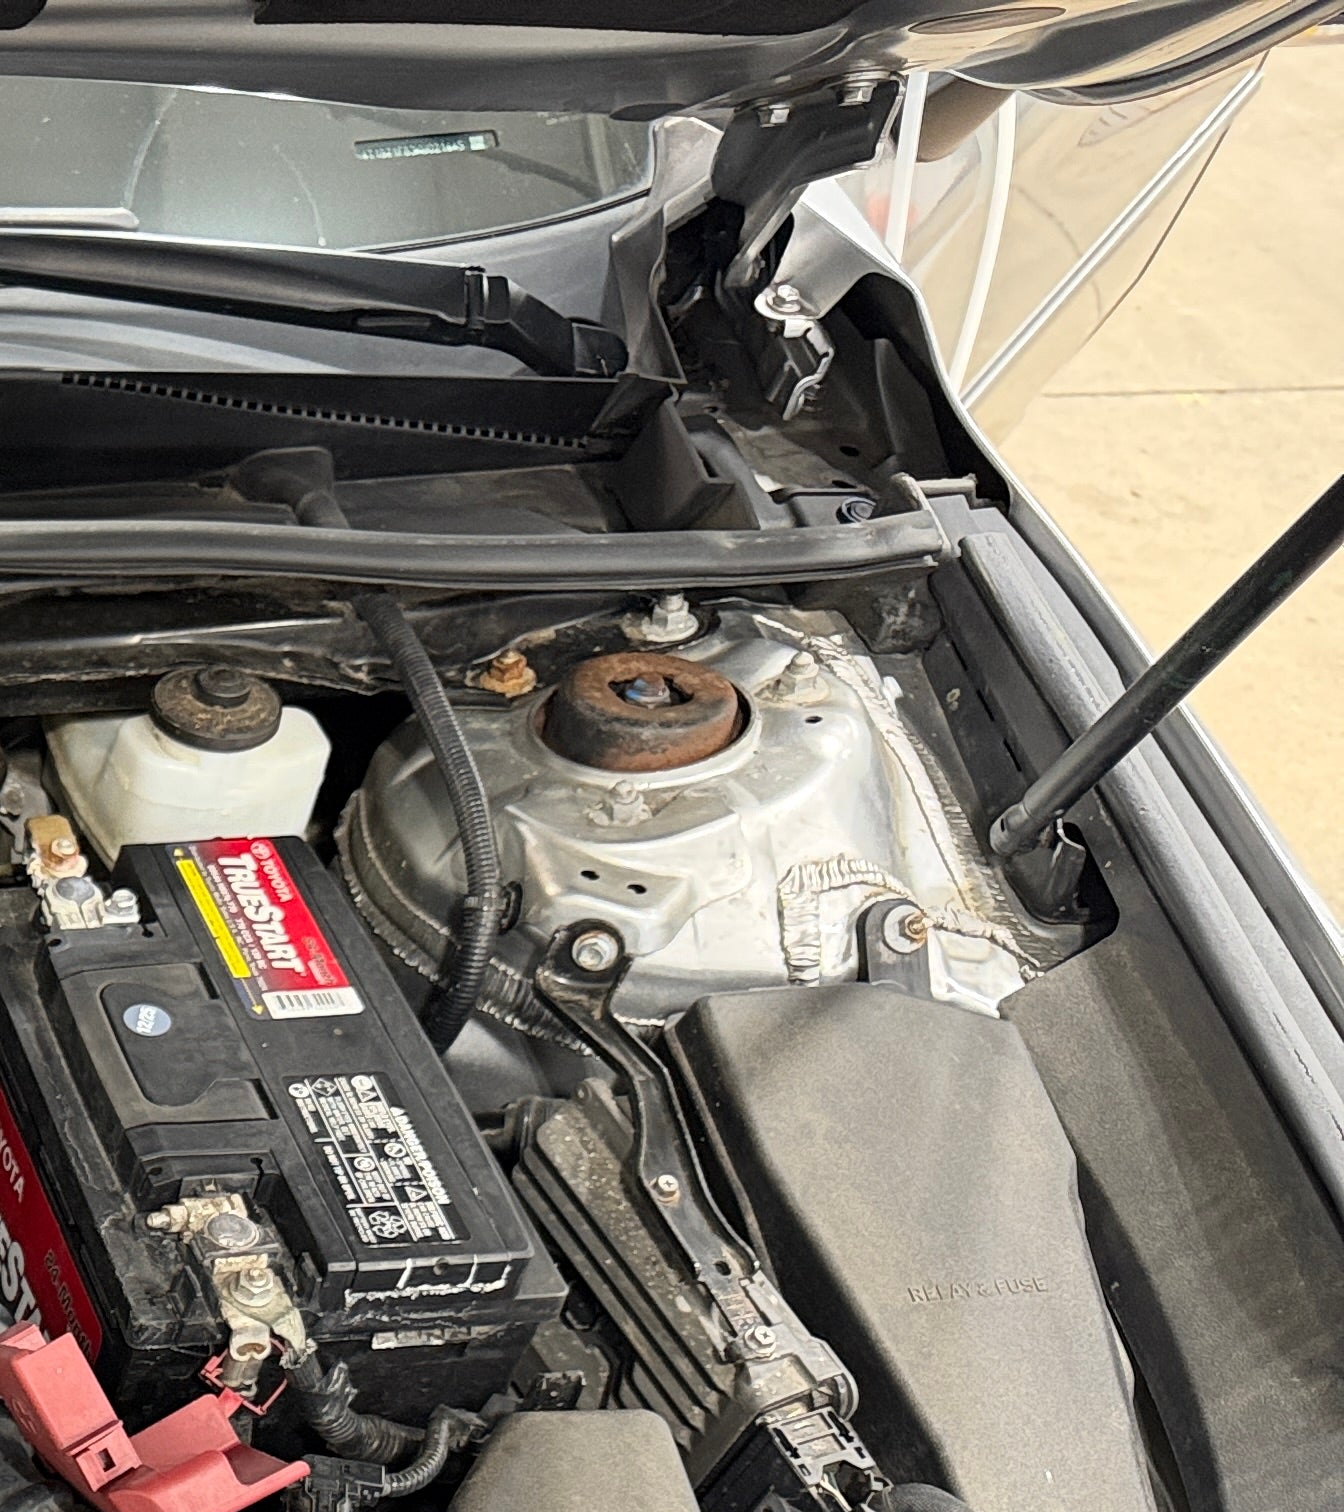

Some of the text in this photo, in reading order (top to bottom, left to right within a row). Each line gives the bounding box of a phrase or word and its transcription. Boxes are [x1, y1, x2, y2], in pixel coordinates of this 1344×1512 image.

[261, 858, 293, 902] TOYOTA
[907, 1276, 1048, 1303] RELAY & FUSE
